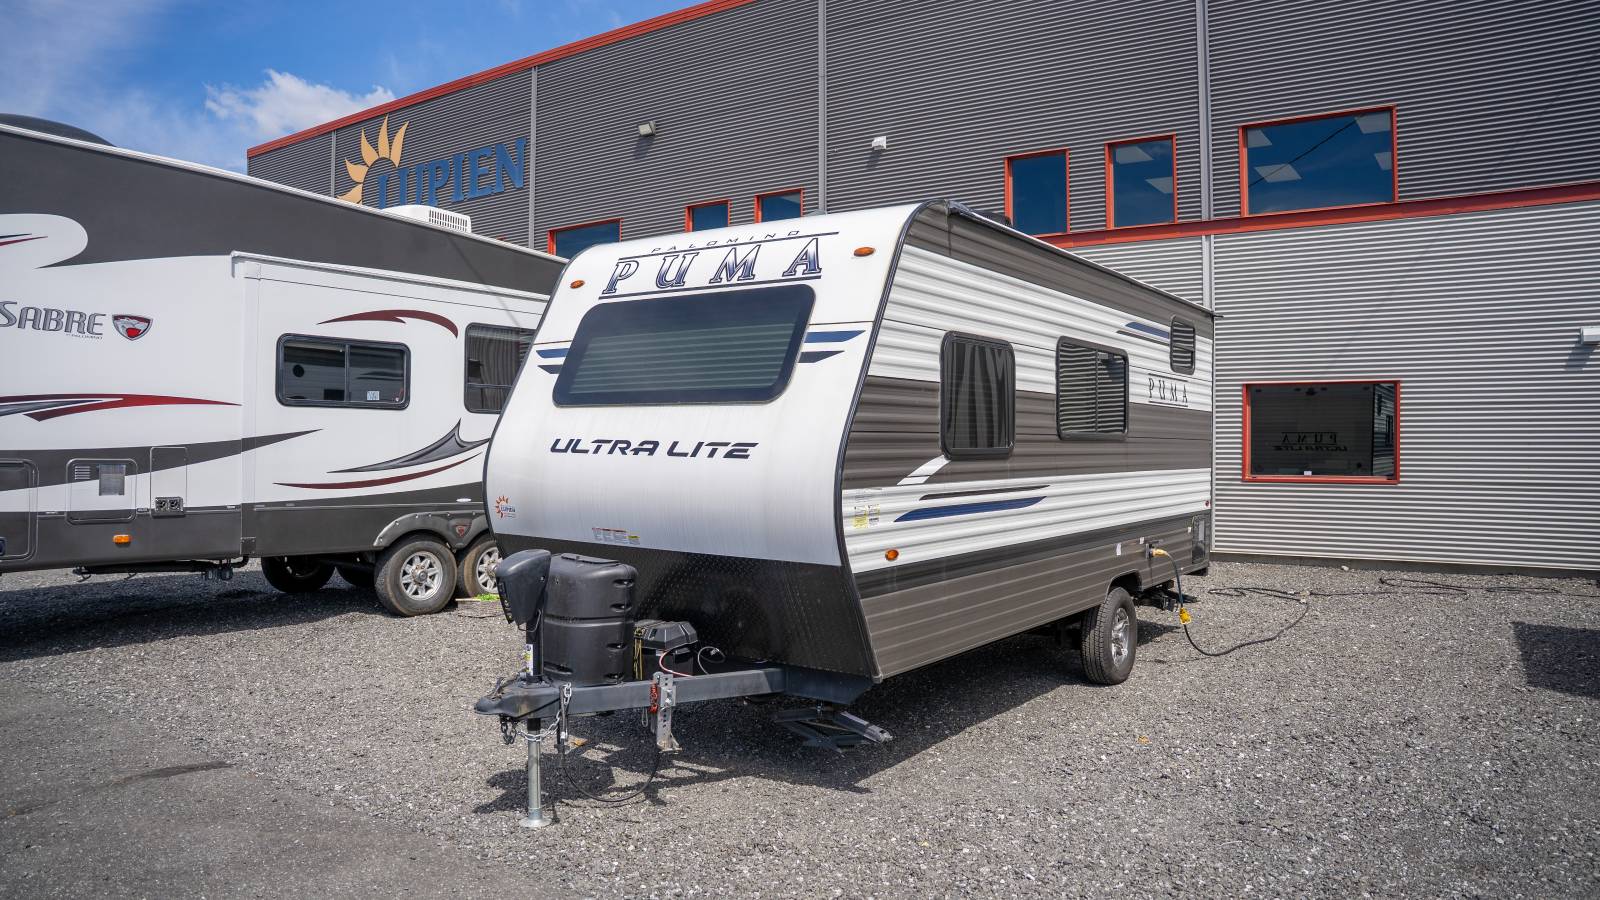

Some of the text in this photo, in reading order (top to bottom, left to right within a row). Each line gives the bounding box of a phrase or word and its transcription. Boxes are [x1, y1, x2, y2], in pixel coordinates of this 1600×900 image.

[376, 137, 527, 210] LUPIEN
[652, 230, 800, 253] PALOMINO
[601, 237, 823, 295] PUMA
[0, 300, 107, 336] SABRE
[1148, 377, 1188, 403] PUMA
[550, 438, 759, 459] ULTRA LITE
